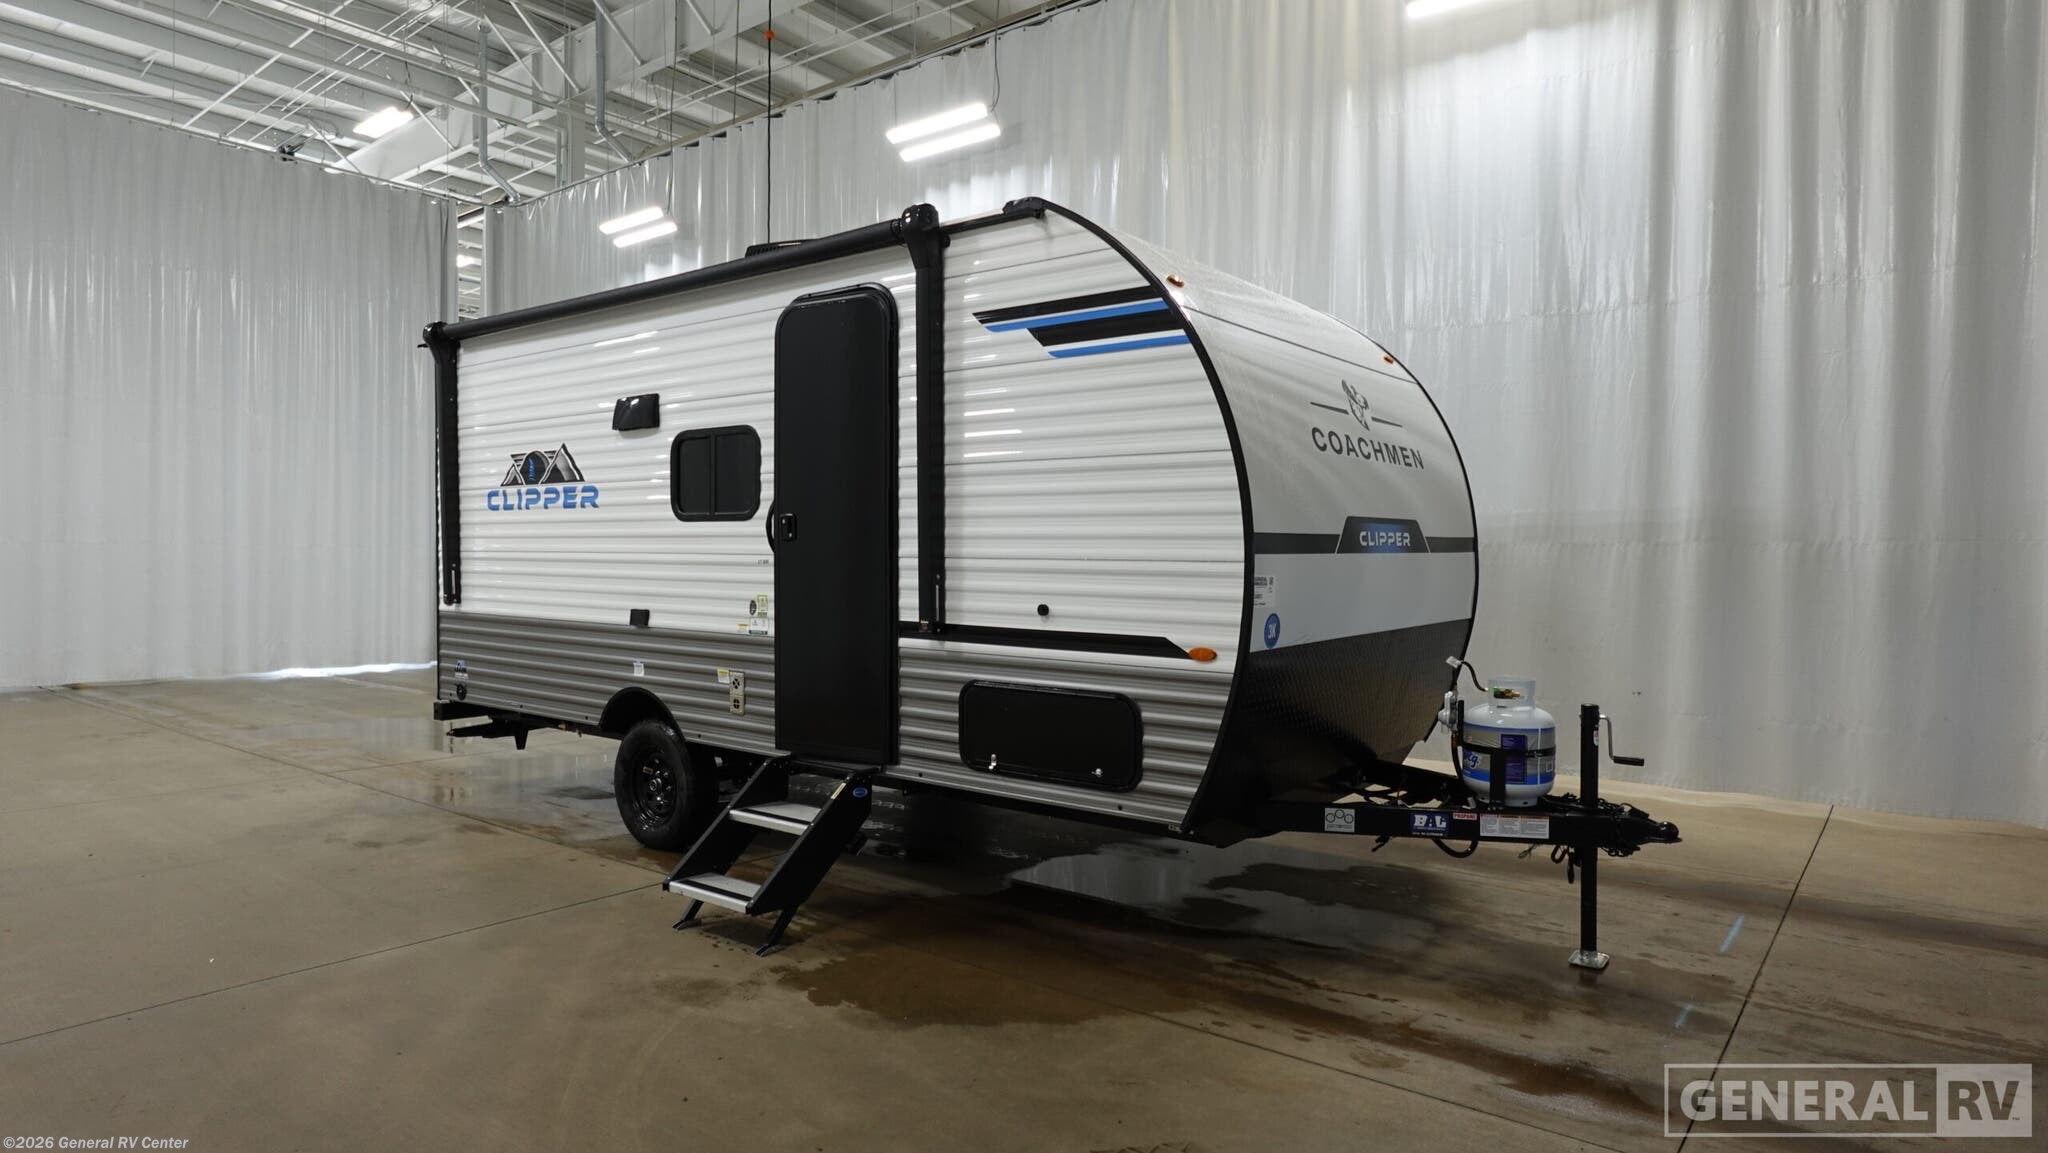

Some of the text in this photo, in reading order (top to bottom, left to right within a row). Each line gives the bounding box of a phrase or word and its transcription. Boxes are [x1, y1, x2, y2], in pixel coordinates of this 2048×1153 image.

[1311, 426, 1425, 470] COACHMEN
[487, 484, 600, 512] CLIPPER
[1359, 530, 1411, 547] CLIPPER
